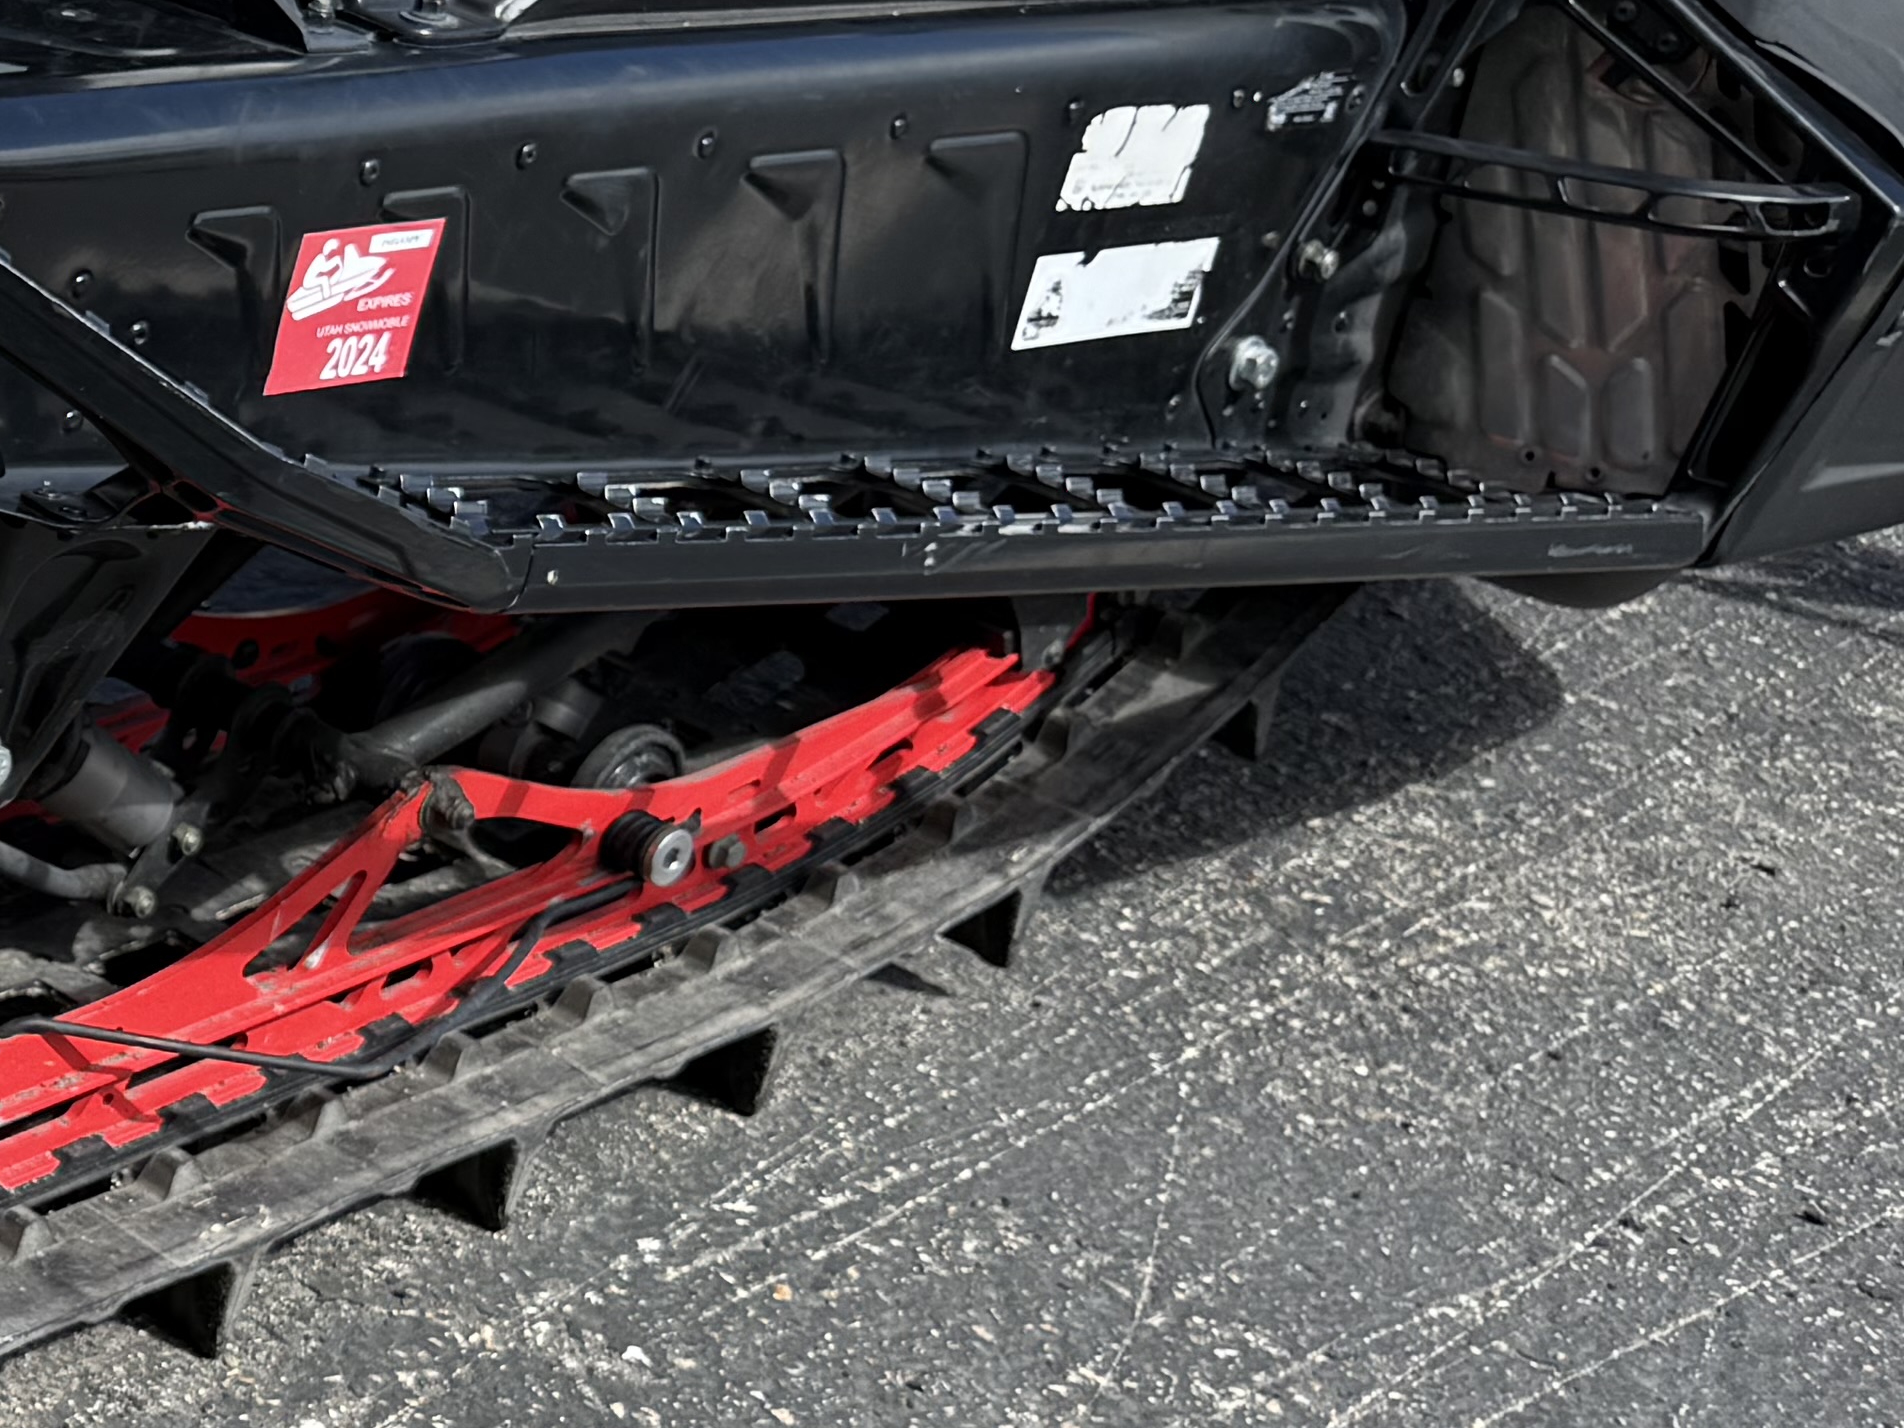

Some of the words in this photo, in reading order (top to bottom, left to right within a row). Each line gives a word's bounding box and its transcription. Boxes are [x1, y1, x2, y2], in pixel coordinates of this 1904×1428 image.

[356, 292, 412, 312] EXPIRES
[316, 325, 342, 338] UTAH
[344, 315, 410, 334] SNOWMOBILE
[319, 332, 392, 380] 2024
